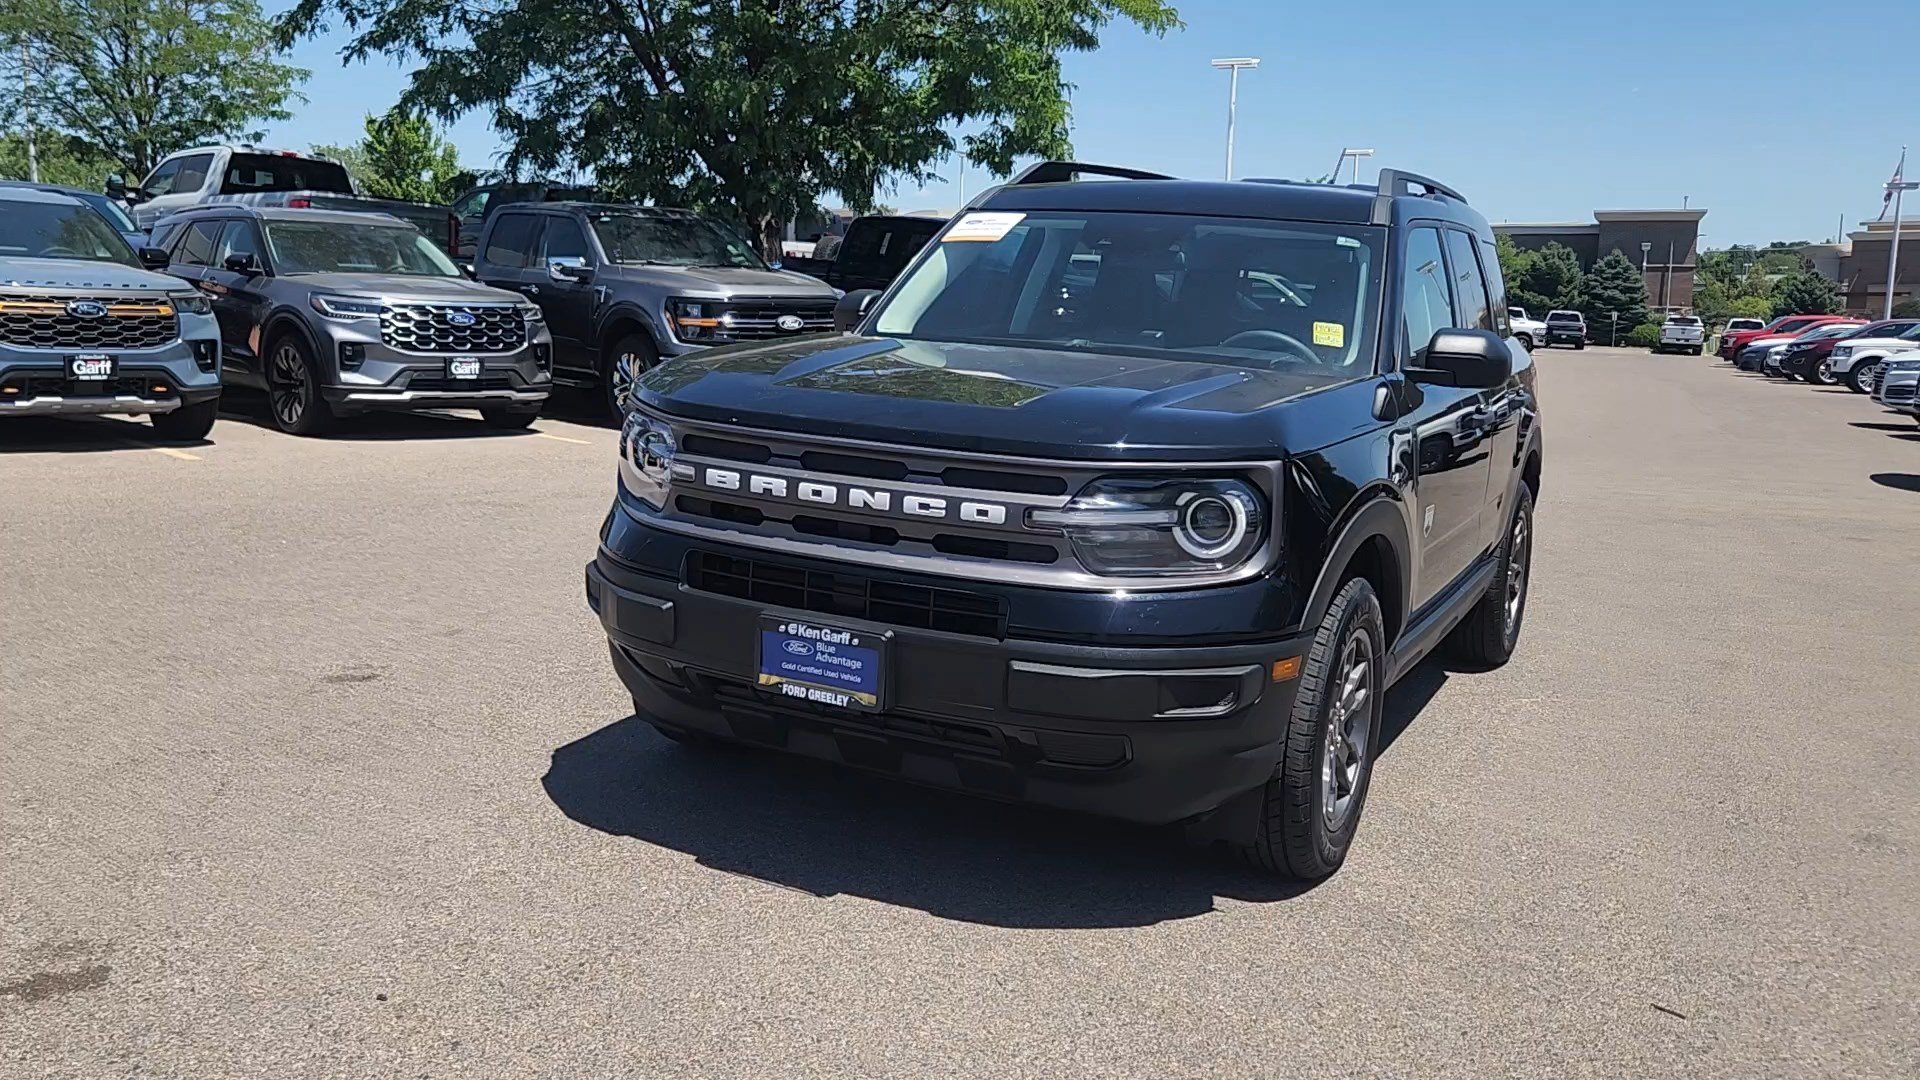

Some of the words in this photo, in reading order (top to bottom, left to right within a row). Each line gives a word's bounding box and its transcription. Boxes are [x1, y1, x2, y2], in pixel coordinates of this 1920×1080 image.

[72, 360, 112, 374] Garff
[451, 362, 480, 374] Garff
[705, 468, 1006, 524] BRONCO
[798, 624, 820, 638] Ken
[821, 628, 851, 644] Garff
[816, 642, 836, 654] Blue
[815, 652, 862, 670] Advantage
[781, 662, 796, 671] Gold
[797, 664, 822, 675] Certified
[823, 669, 839, 679] Used
[840, 672, 862, 683] Vehicle
[782, 684, 806, 698] FORD
[808, 689, 849, 707] GREELEY
